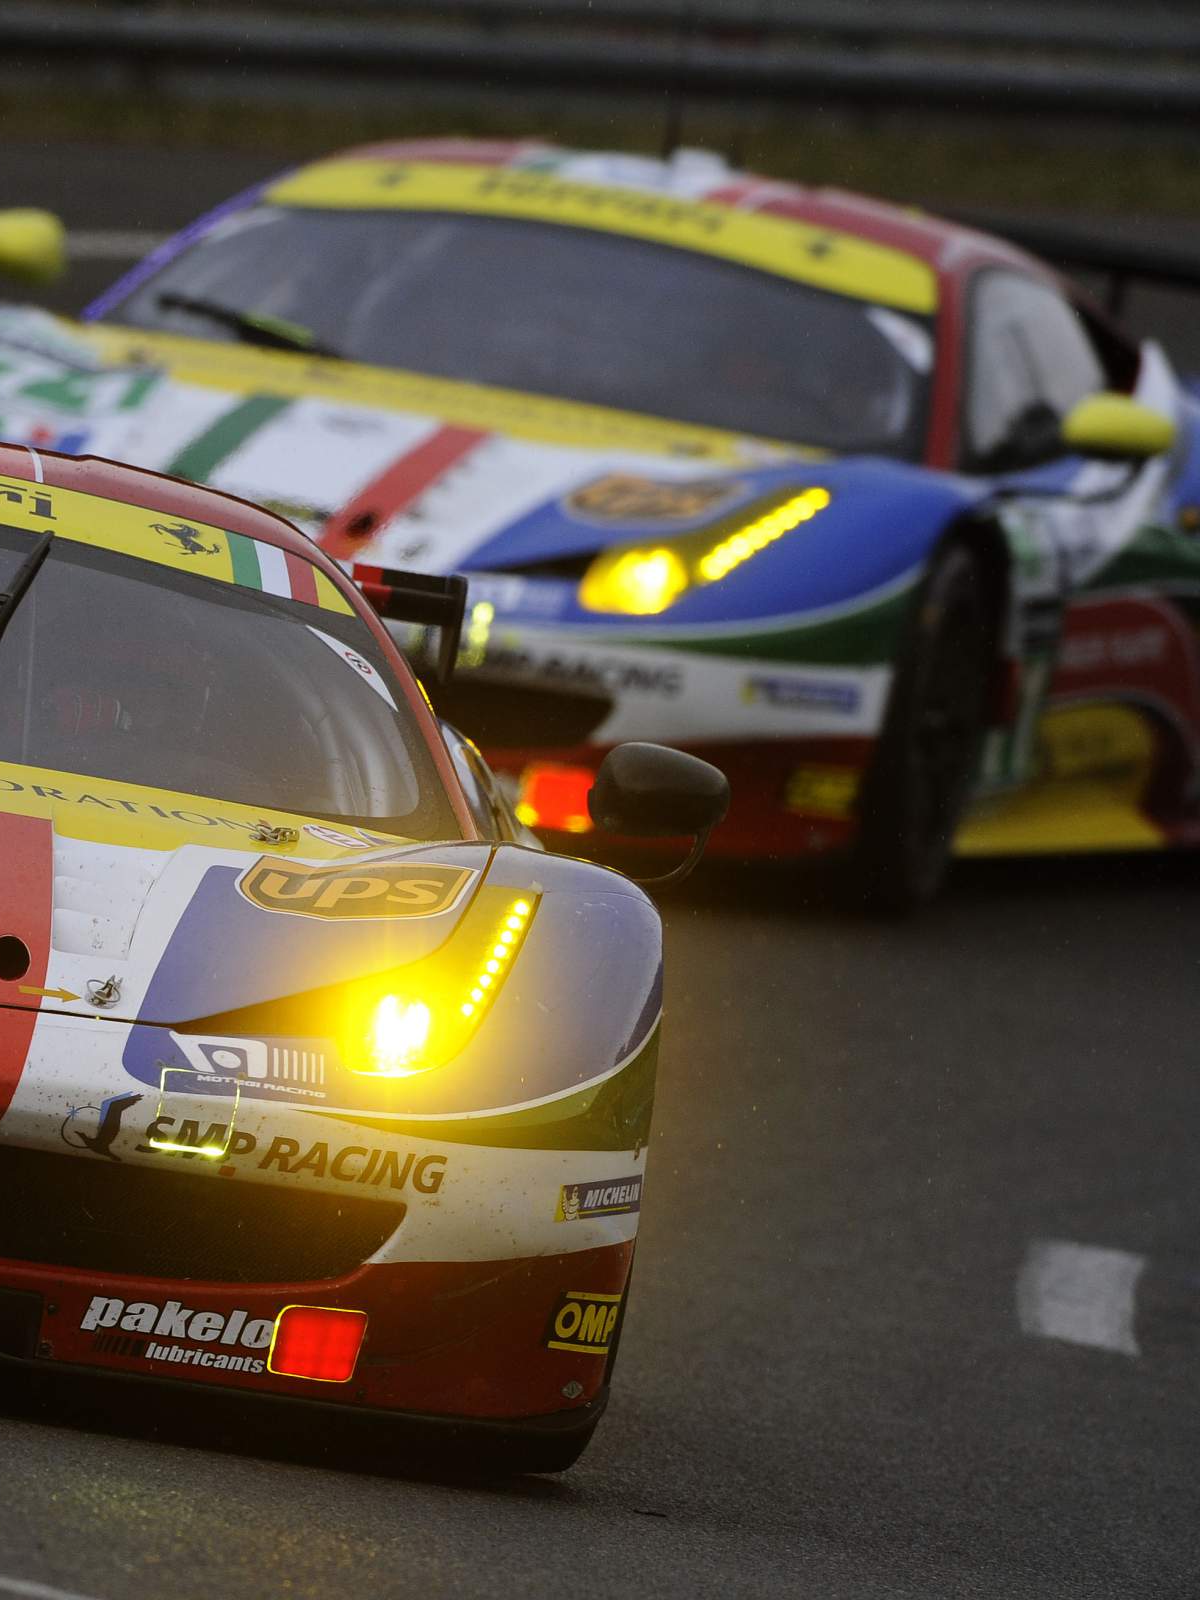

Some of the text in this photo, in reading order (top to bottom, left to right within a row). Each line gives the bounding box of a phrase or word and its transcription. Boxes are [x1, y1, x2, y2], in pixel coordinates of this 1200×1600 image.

[259, 871, 444, 908] ups
[263, 1082, 327, 1099] RACING
[135, 1116, 448, 1194] SMP RACING
[584, 1183, 641, 1209] MICHELIN
[80, 1296, 276, 1349] pakelo
[555, 1302, 618, 1343] OMP
[145, 1341, 265, 1374] lubricants
